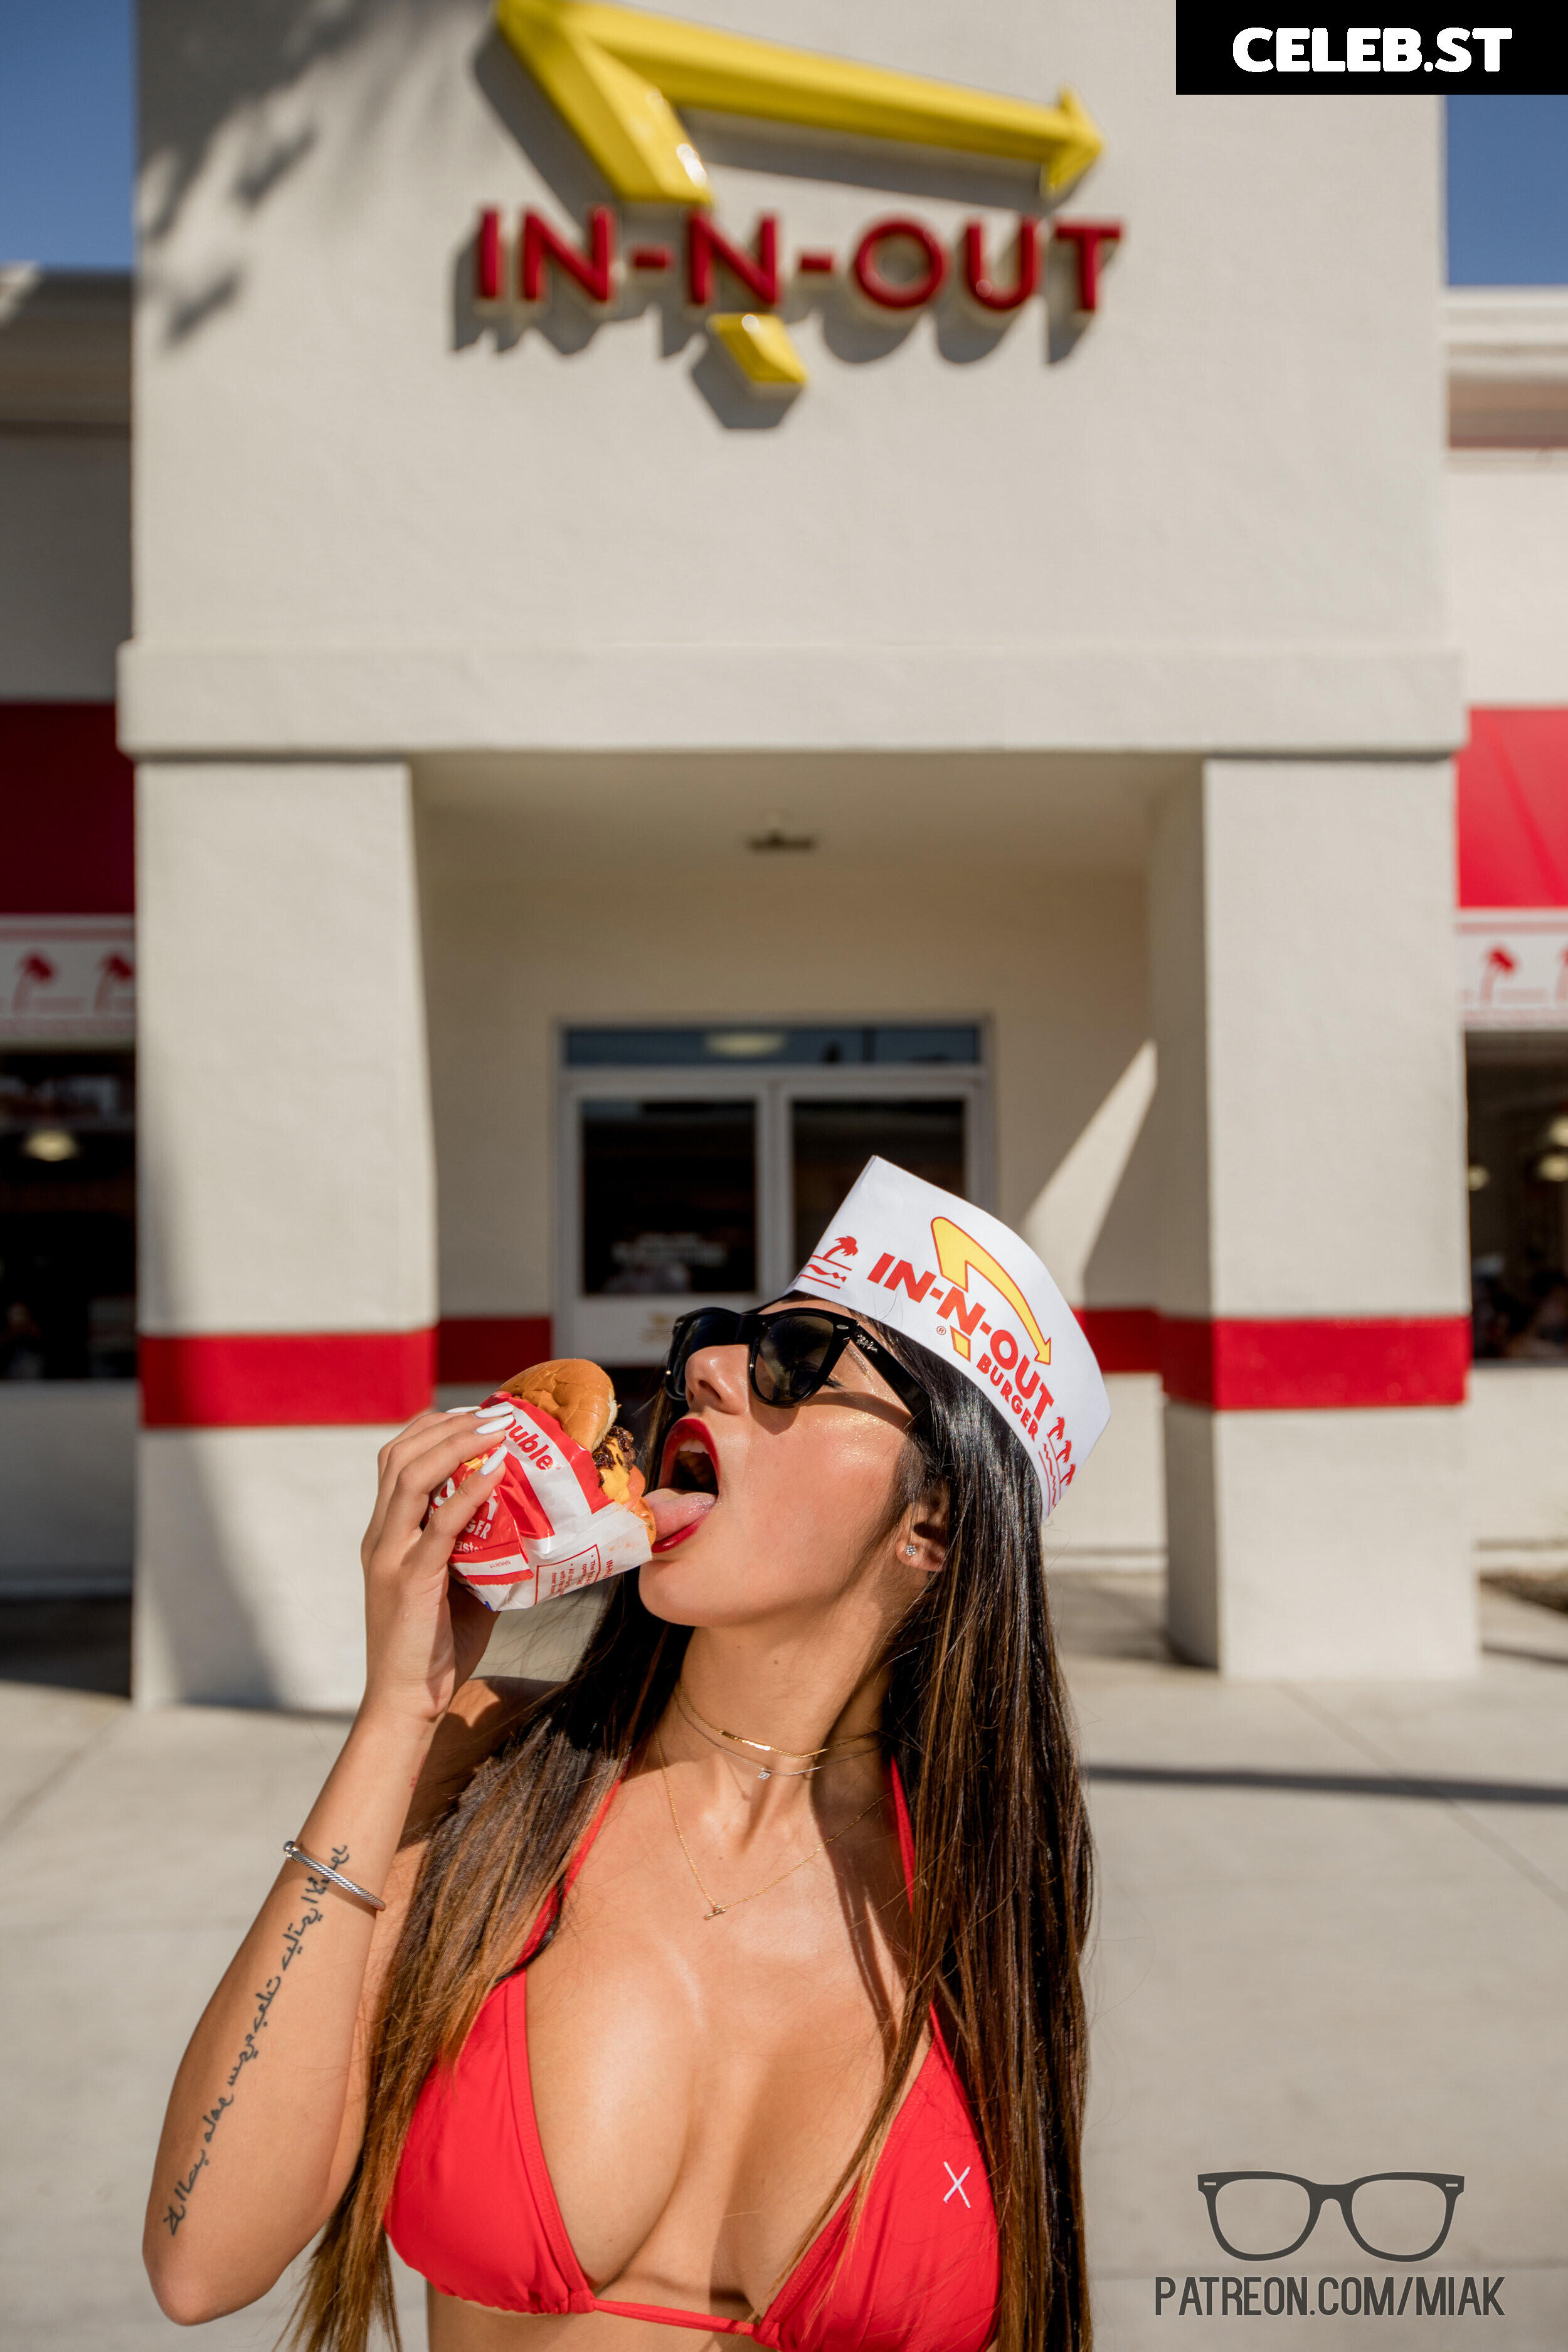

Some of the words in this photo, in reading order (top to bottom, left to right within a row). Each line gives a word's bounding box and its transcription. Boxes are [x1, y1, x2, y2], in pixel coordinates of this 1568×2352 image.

[477, 208, 1121, 311] IN-N-OUT
[867, 1253, 1054, 1422] IN-N-OUT
[976, 1353, 1040, 1440] BURGER
[504, 1419, 553, 1470] uble
